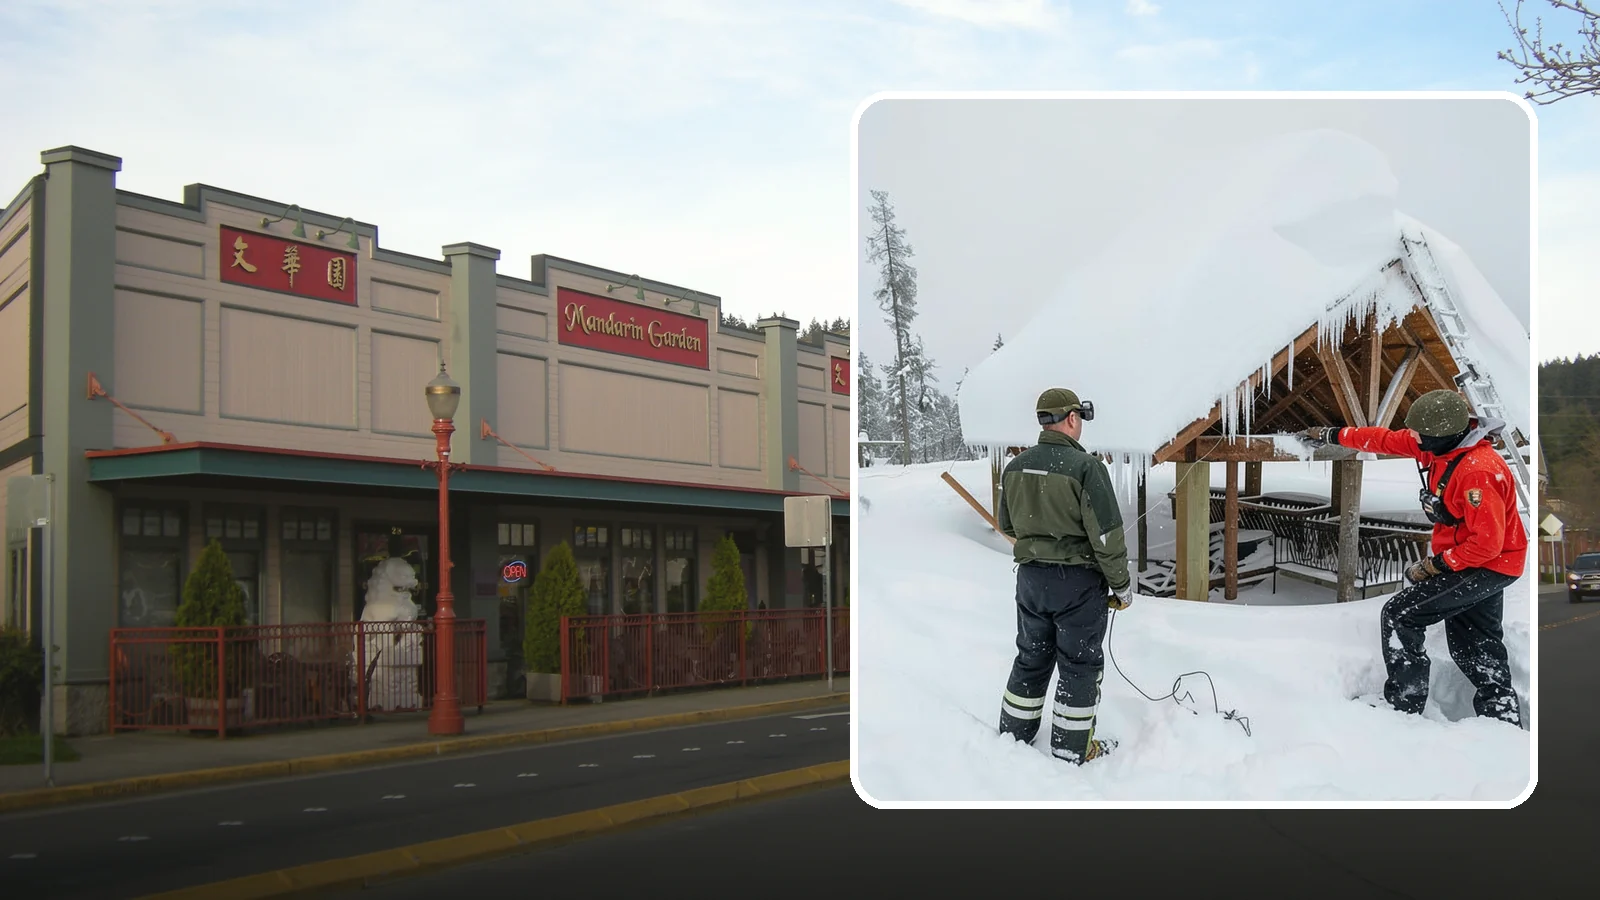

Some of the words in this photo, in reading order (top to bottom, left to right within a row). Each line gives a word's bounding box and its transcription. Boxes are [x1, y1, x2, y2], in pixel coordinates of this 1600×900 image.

[231, 236, 346, 291] 文華園
[565, 302, 644, 341] Mandarin
[648, 320, 701, 352] Garden
[503, 565, 527, 578] OPEN
